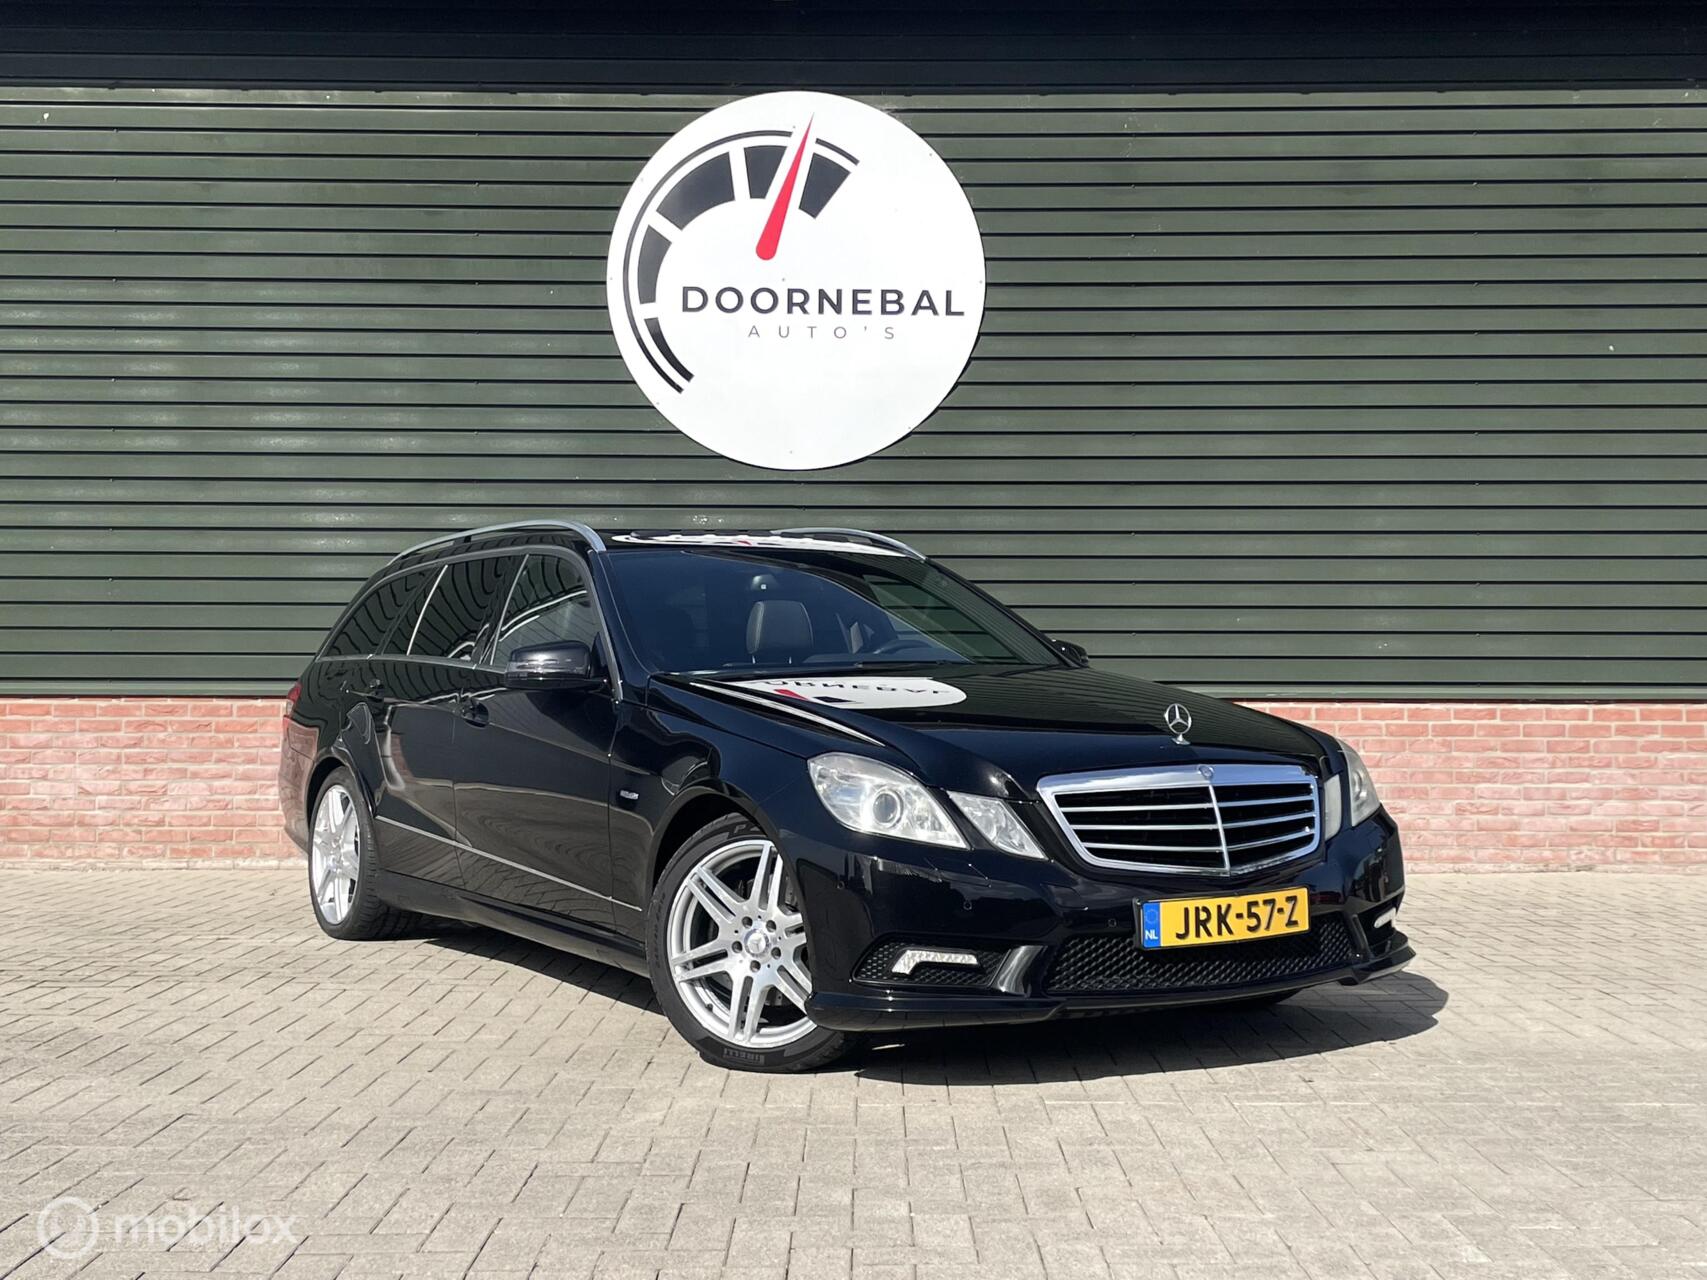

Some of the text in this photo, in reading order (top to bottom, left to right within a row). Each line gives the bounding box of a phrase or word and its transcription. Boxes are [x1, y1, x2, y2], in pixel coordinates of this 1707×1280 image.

[681, 286, 965, 316] DOORNEBAL
[747, 325, 895, 340] AUTO'S
[1175, 895, 1299, 940] JRK-57-Z
[1144, 930, 1159, 940] NL
